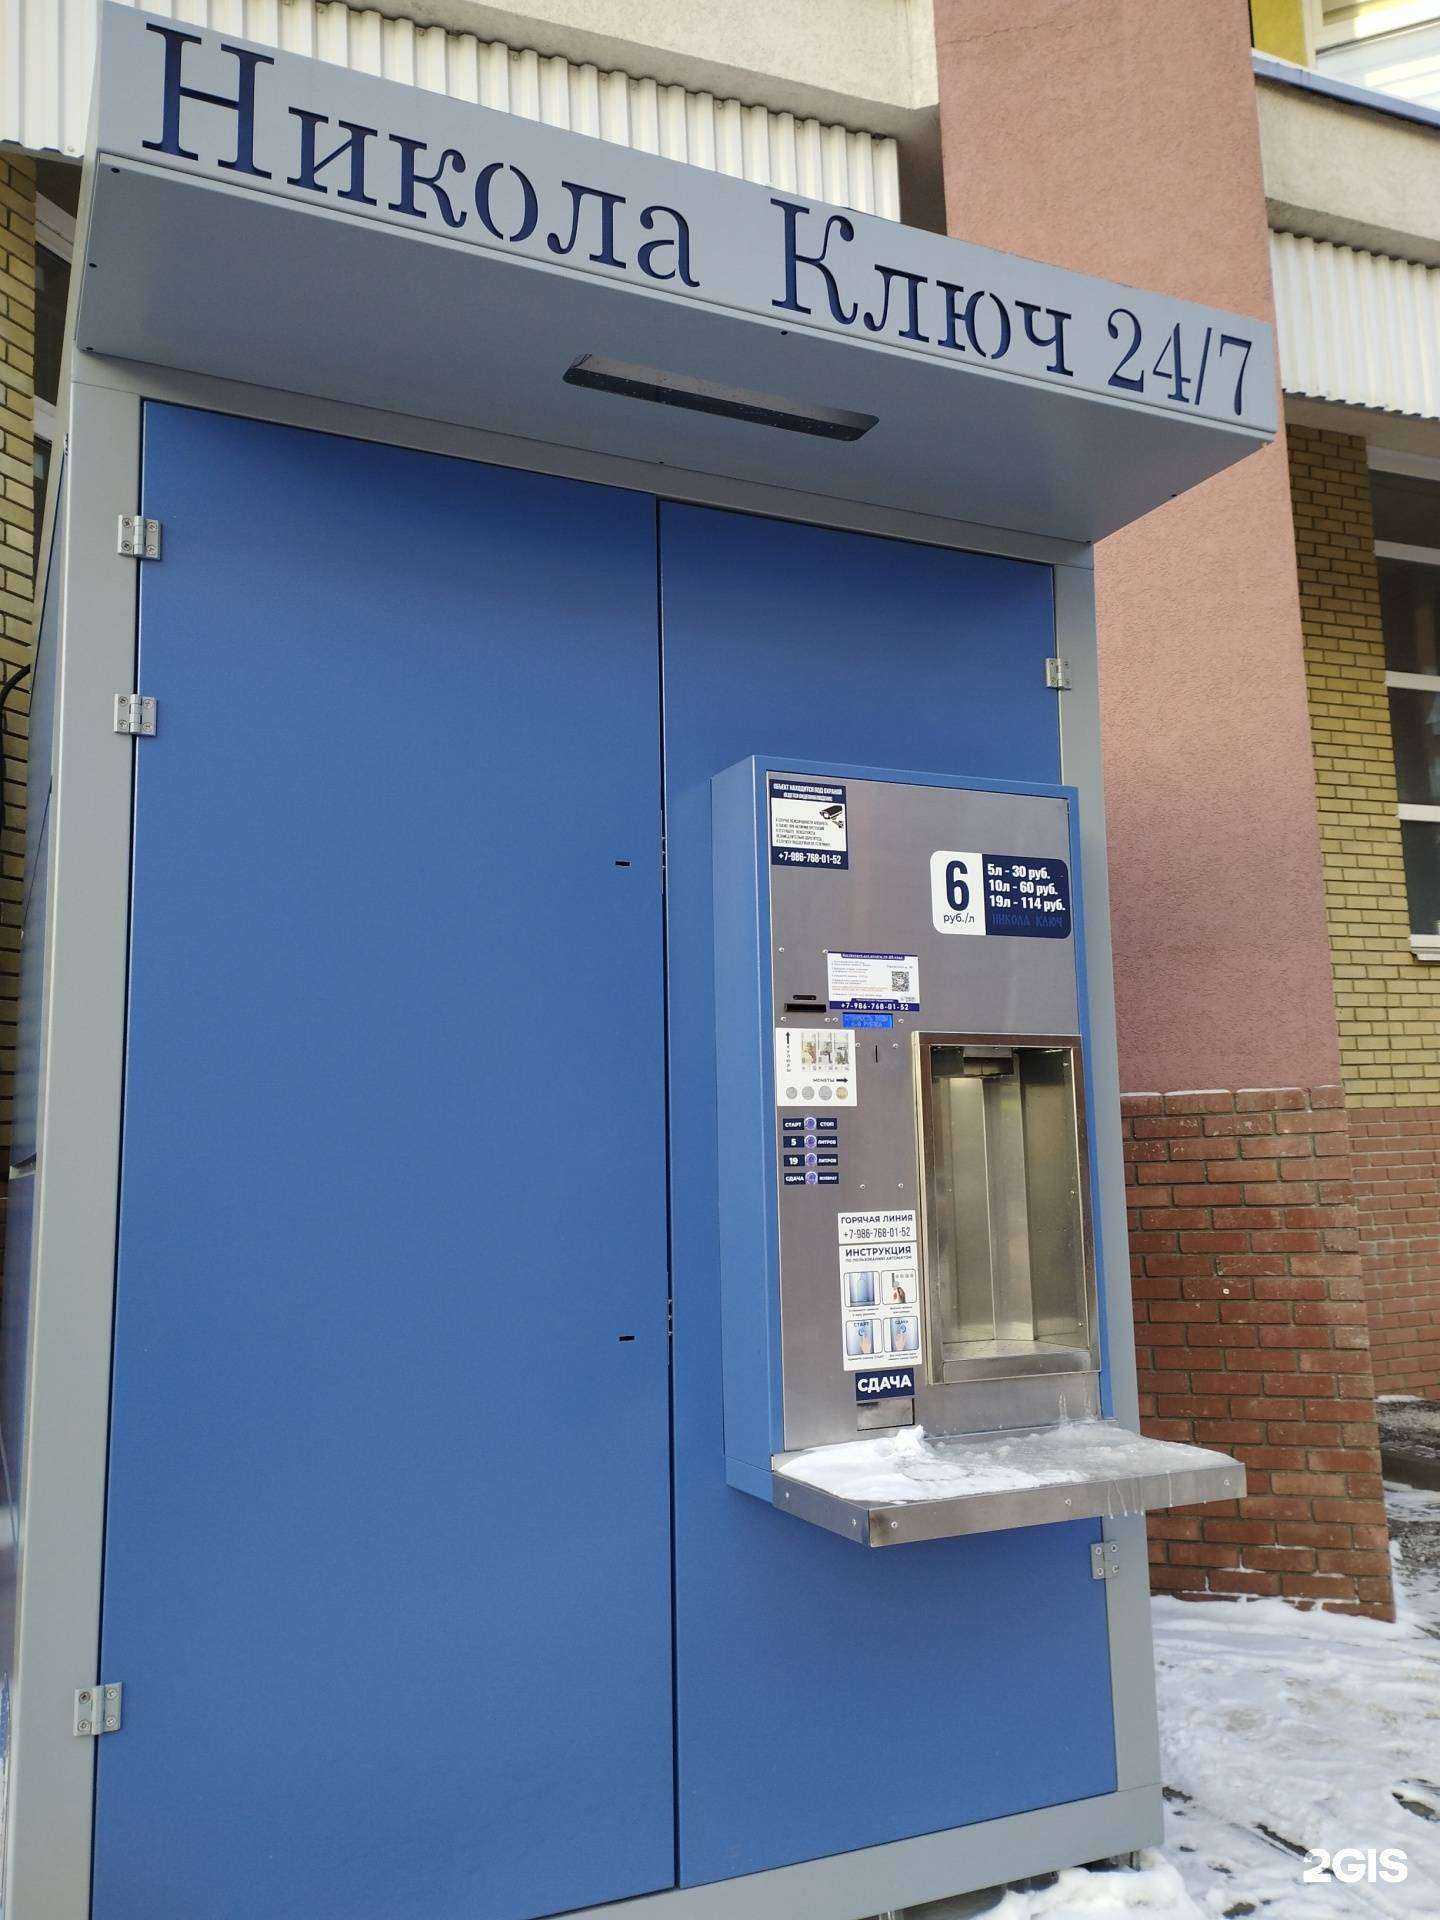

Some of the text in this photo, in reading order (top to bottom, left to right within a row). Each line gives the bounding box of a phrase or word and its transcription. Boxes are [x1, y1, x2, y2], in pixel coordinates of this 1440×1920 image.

[142, 23, 1252, 416] Никола Ключ 24/7
[778, 851, 842, 865] +7-986-768-01-52
[987, 863, 1003, 876] 5л
[1012, 865, 1026, 878] 30
[1028, 867, 1051, 880] руб.
[945, 860, 970, 912] 6
[988, 879, 1010, 892] 10л
[1019, 881, 1034, 894] 60
[1036, 883, 1058, 896] руб.
[989, 895, 1011, 908] 19л
[1020, 897, 1042, 909] 114
[1043, 899, 1066, 912] руб.
[943, 912, 975, 924] руб./л
[841, 1002, 909, 1011] +7-986-768-01-52
[791, 1138, 797, 1146] 5
[789, 1157, 799, 1165] 19
[841, 1214, 913, 1224] ГОРЯЧАЯ ЛИНИЯ
[844, 1226, 911, 1239] +7-986-768-01-52
[845, 1245, 912, 1257] ИНСТРУКЦИЯ
[857, 1374, 912, 1394] СДАЧА
